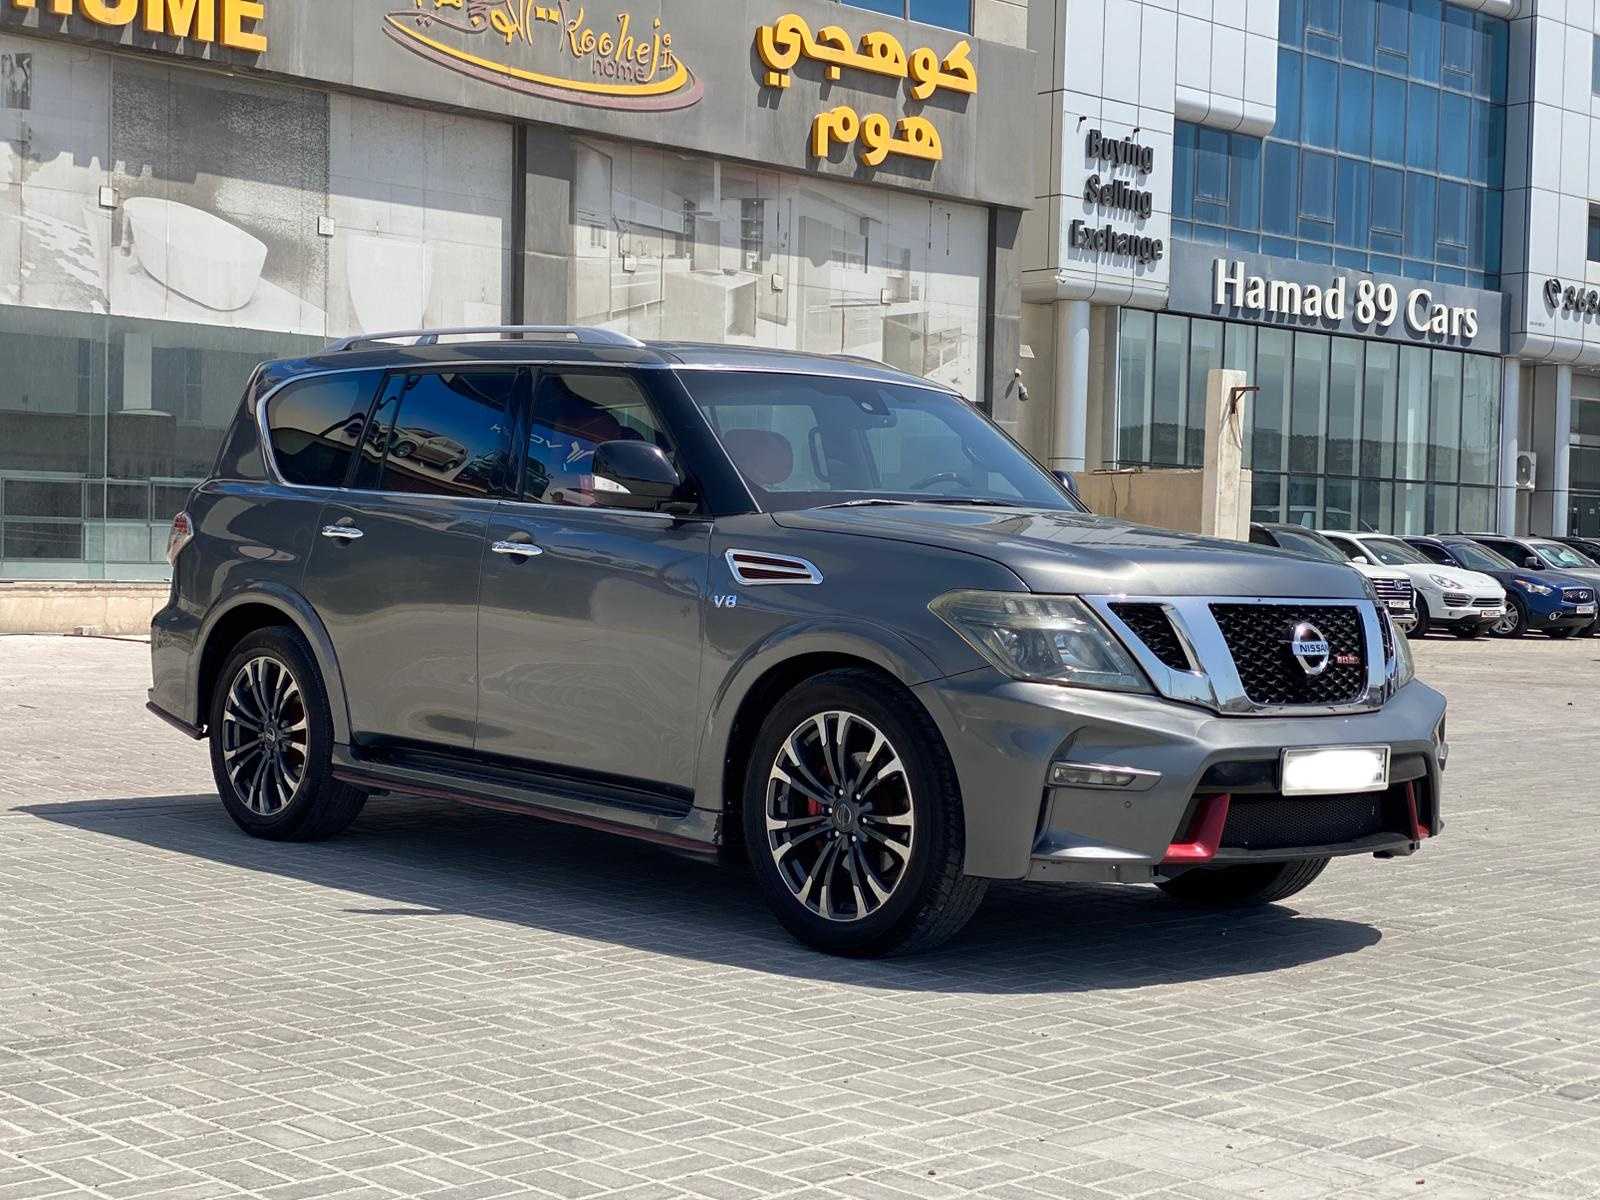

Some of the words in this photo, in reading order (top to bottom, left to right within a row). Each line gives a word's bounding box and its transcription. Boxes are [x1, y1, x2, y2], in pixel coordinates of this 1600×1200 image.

[10, 0, 268, 53] ME
[756, 13, 977, 100] كوهجي
[812, 105, 943, 167] هوم
[1085, 129, 1154, 175] Buying
[1083, 174, 1153, 219] Selling
[1071, 219, 1163, 265] Exchange
[1213, 258, 1345, 321] Hamad
[1355, 279, 1398, 327] 89
[1406, 288, 1479, 339] Cars
[713, 594, 737, 608] V8
